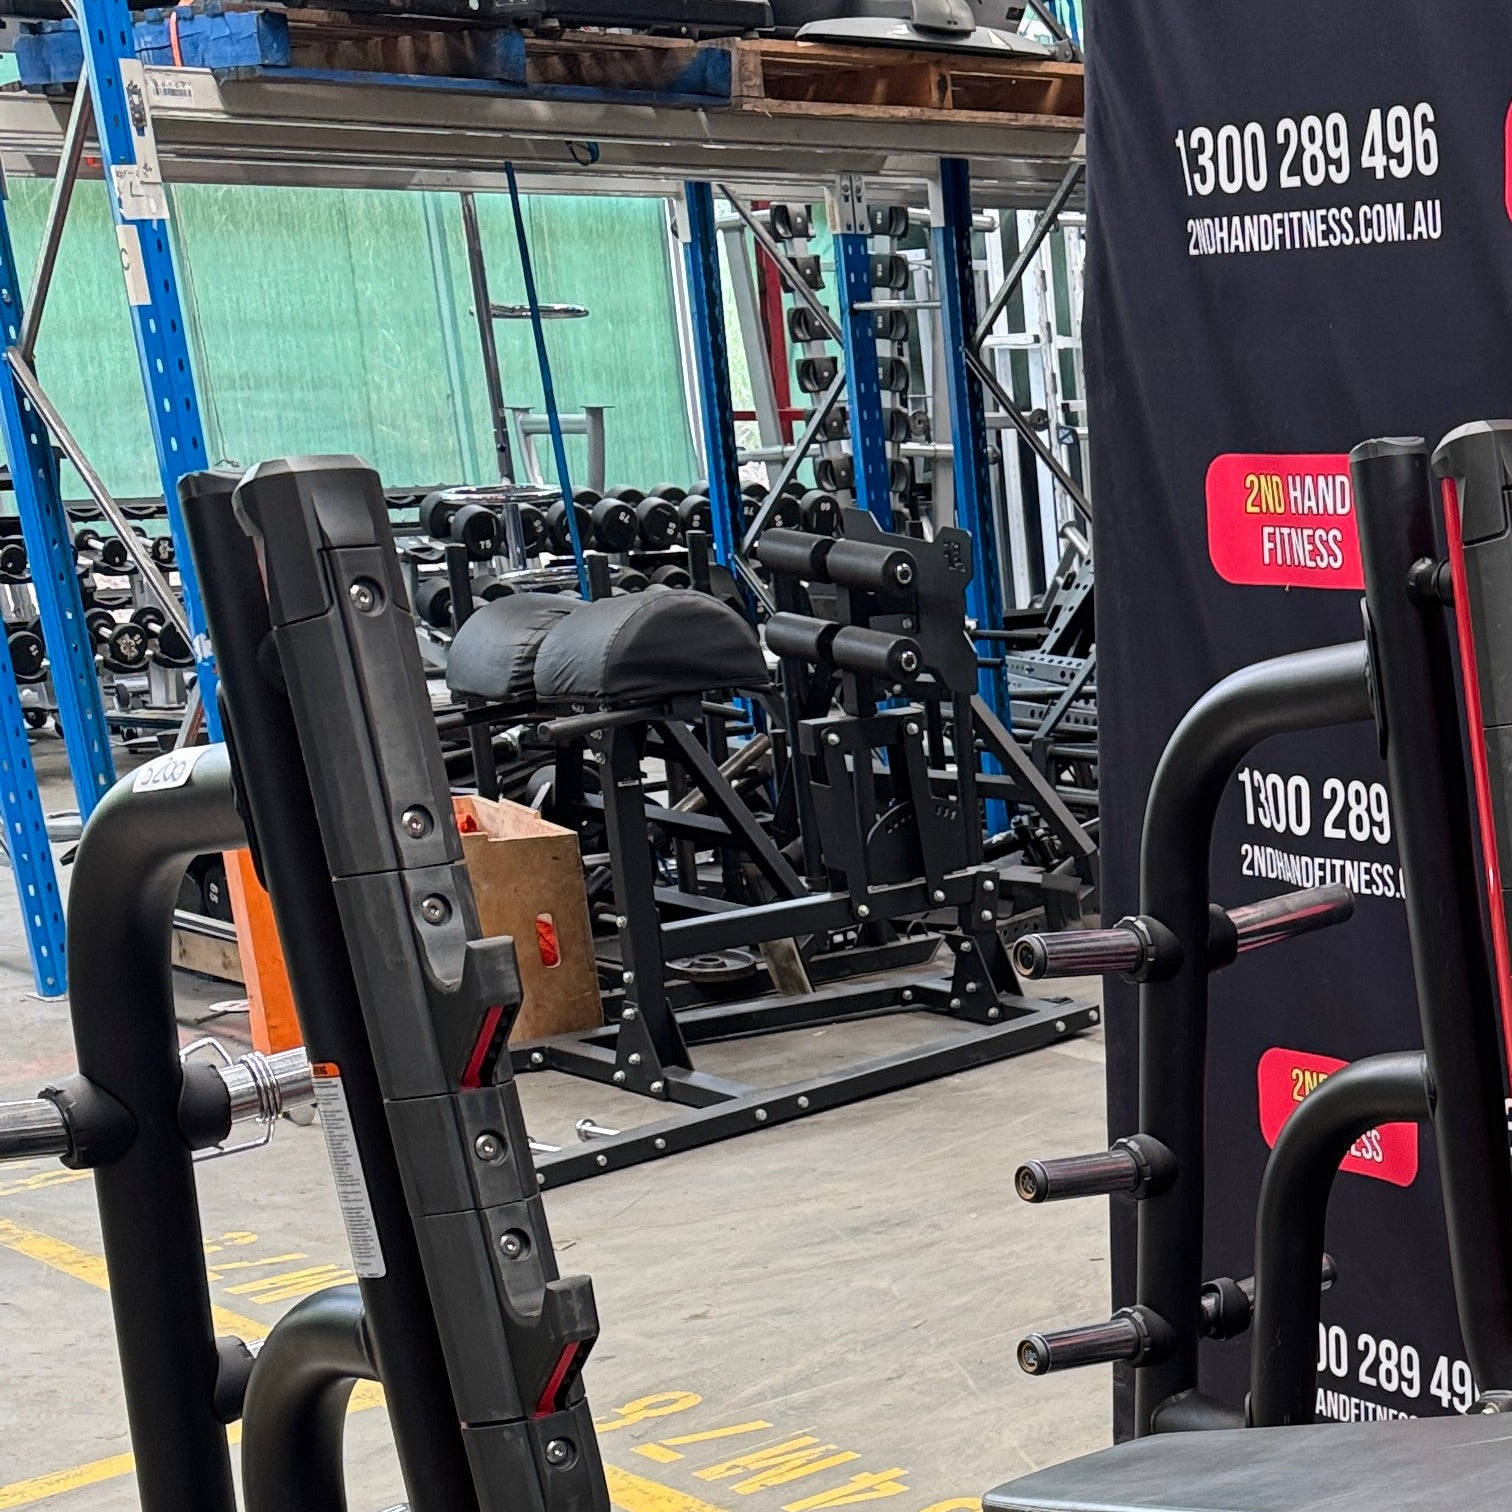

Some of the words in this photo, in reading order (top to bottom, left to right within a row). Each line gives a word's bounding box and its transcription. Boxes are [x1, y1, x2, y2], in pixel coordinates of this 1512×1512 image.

[1174, 121, 1268, 197] 1300
[1276, 112, 1350, 189] 289
[1360, 102, 1439, 180] 496
[1187, 199, 1442, 256] 2NDHANDFITNESS.COM.AU
[1245, 474, 1285, 514] 2ND
[1287, 475, 1351, 515] HAND
[1262, 526, 1343, 569] FITNESS
[1238, 767, 1311, 836] 1300
[1322, 777, 1391, 845] 289
[1240, 843, 1406, 899] 2NDHANDFITNESS.
[1357, 1333, 1421, 1398] 289
[1429, 1355, 1481, 1414] 49
